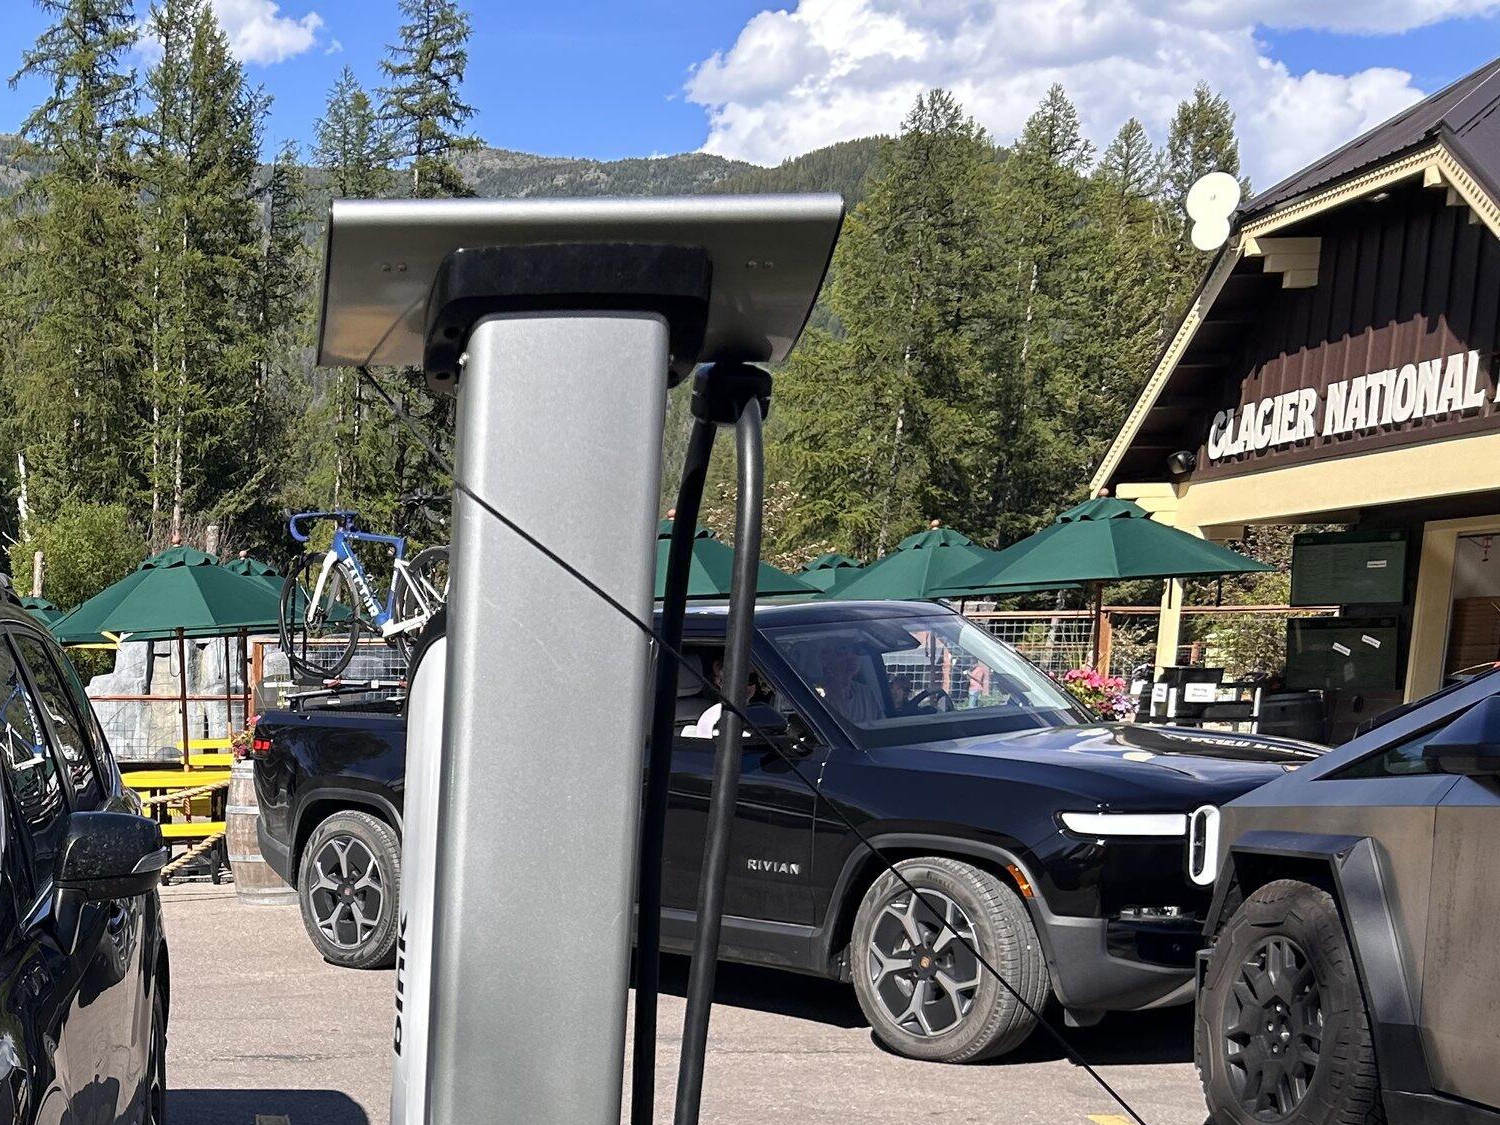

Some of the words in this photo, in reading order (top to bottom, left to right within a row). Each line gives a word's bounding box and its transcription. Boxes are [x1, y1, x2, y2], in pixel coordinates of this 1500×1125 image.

[1207, 387, 1317, 460] GLACIER
[1322, 350, 1486, 436] NATIONAL
[747, 858, 800, 875] RIVIAN
